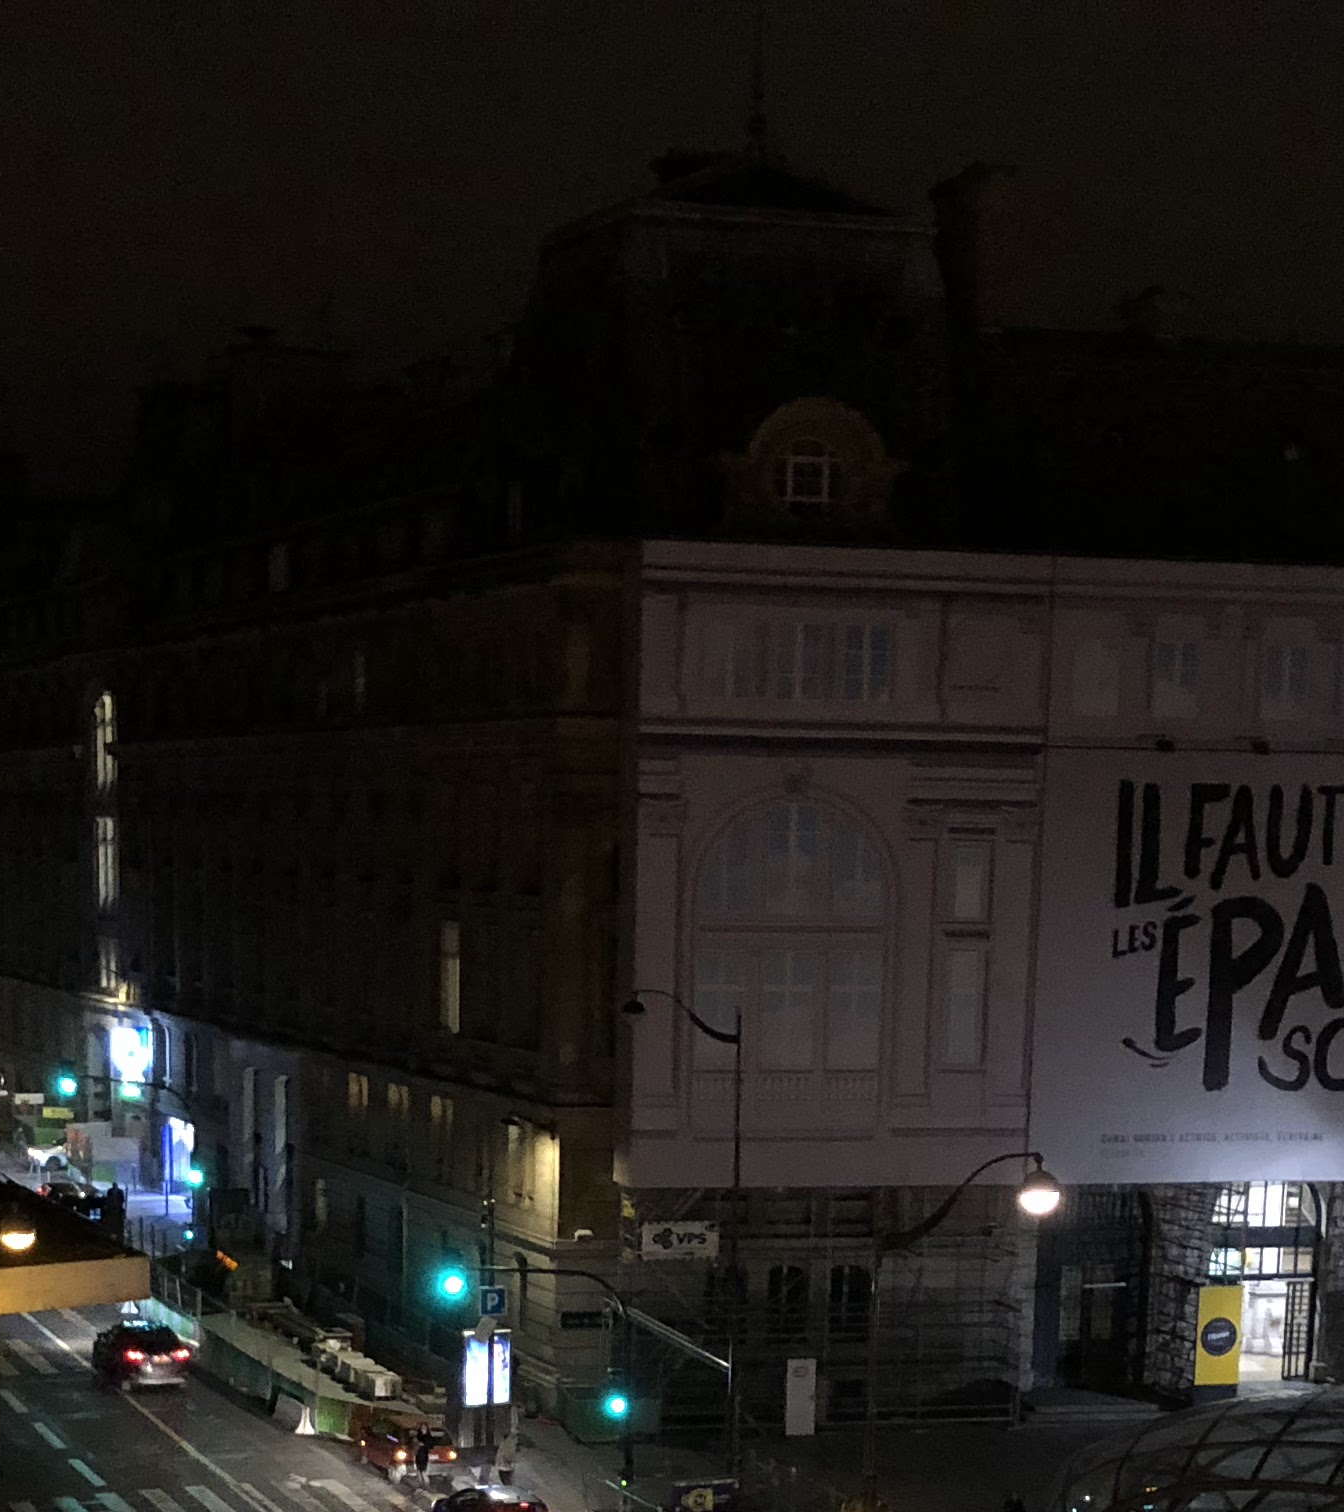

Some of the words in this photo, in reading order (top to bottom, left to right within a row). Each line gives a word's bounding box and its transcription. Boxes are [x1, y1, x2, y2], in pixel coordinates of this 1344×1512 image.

[1114, 779, 1184, 908] IL
[1112, 920, 1158, 958] LES
[675, 1232, 707, 1245] VPS
[486, 1292, 499, 1311] P
